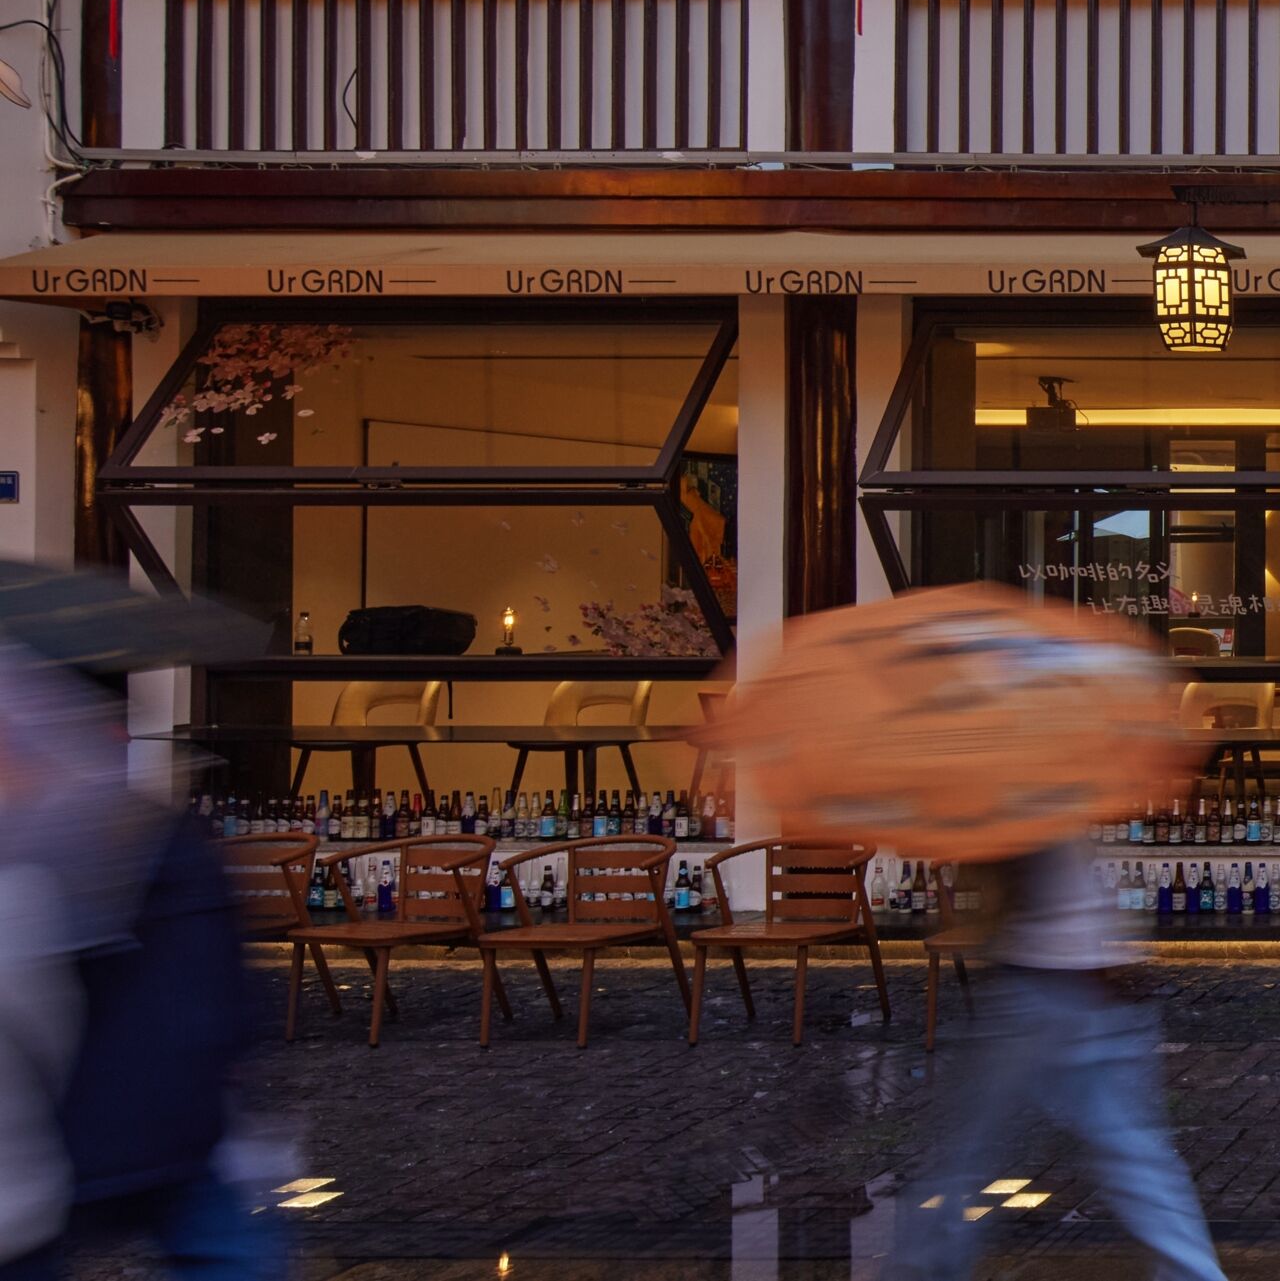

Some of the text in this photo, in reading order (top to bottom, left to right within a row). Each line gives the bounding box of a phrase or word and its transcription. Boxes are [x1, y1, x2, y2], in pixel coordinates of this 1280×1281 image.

[1018, 560, 1180, 583] 以咖啡的名义
